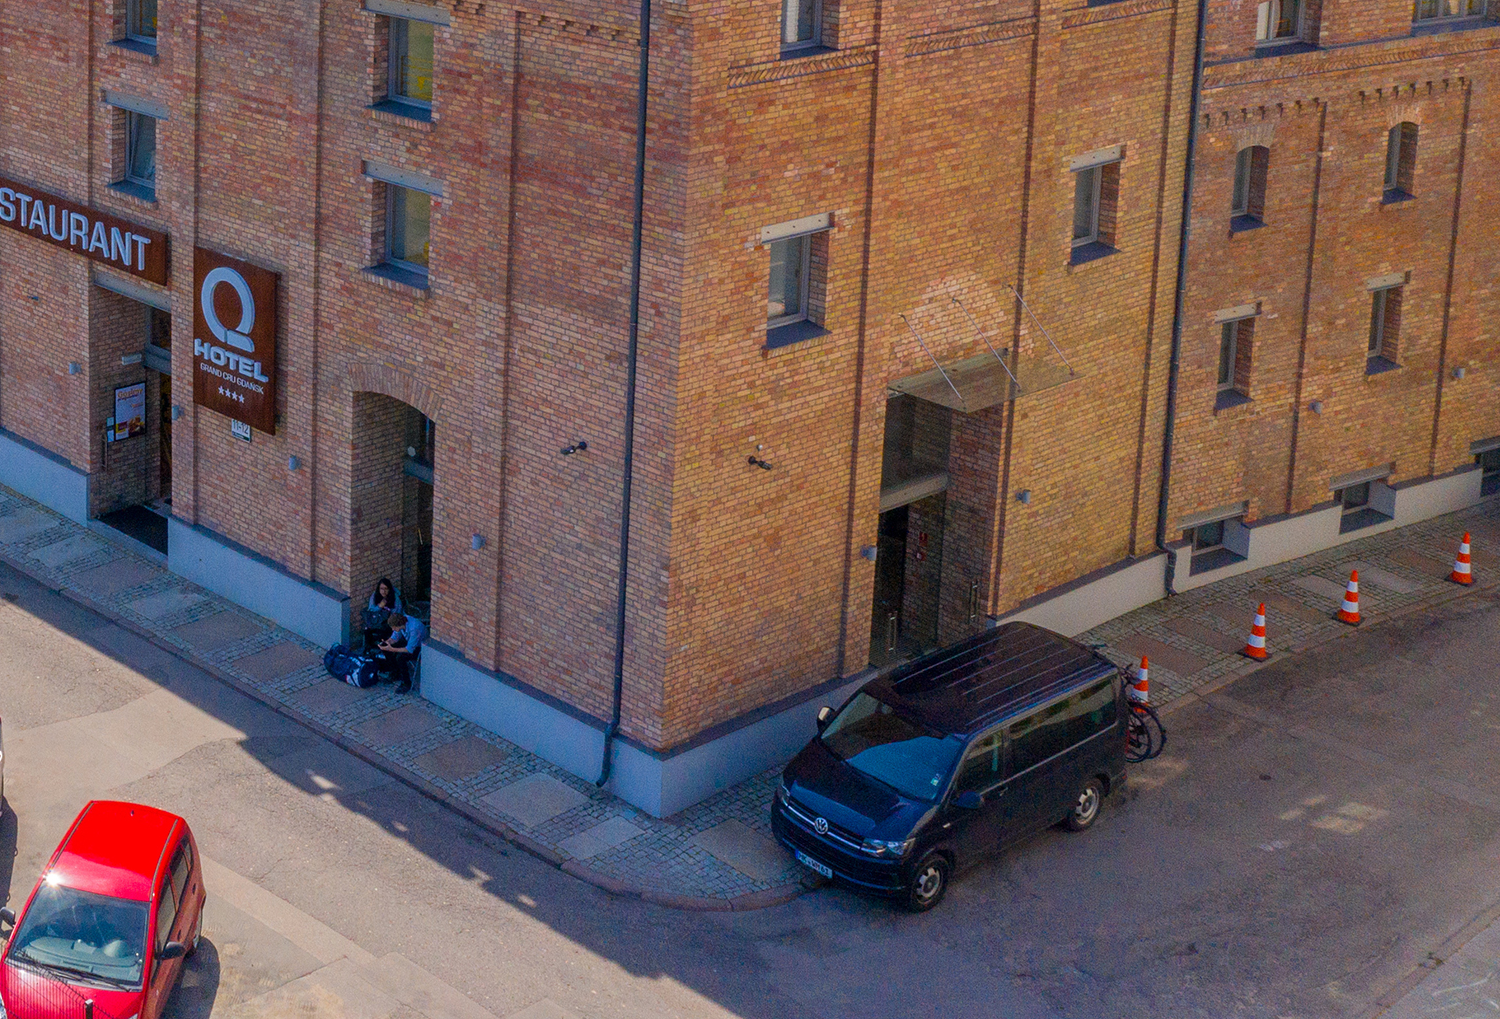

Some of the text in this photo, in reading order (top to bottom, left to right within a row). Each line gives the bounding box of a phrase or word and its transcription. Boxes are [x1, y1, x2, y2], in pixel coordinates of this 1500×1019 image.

[201, 266, 256, 353] Q
[194, 338, 269, 383] HOTEL
[200, 362, 222, 378] GRAND
[222, 369, 237, 384] CRU
